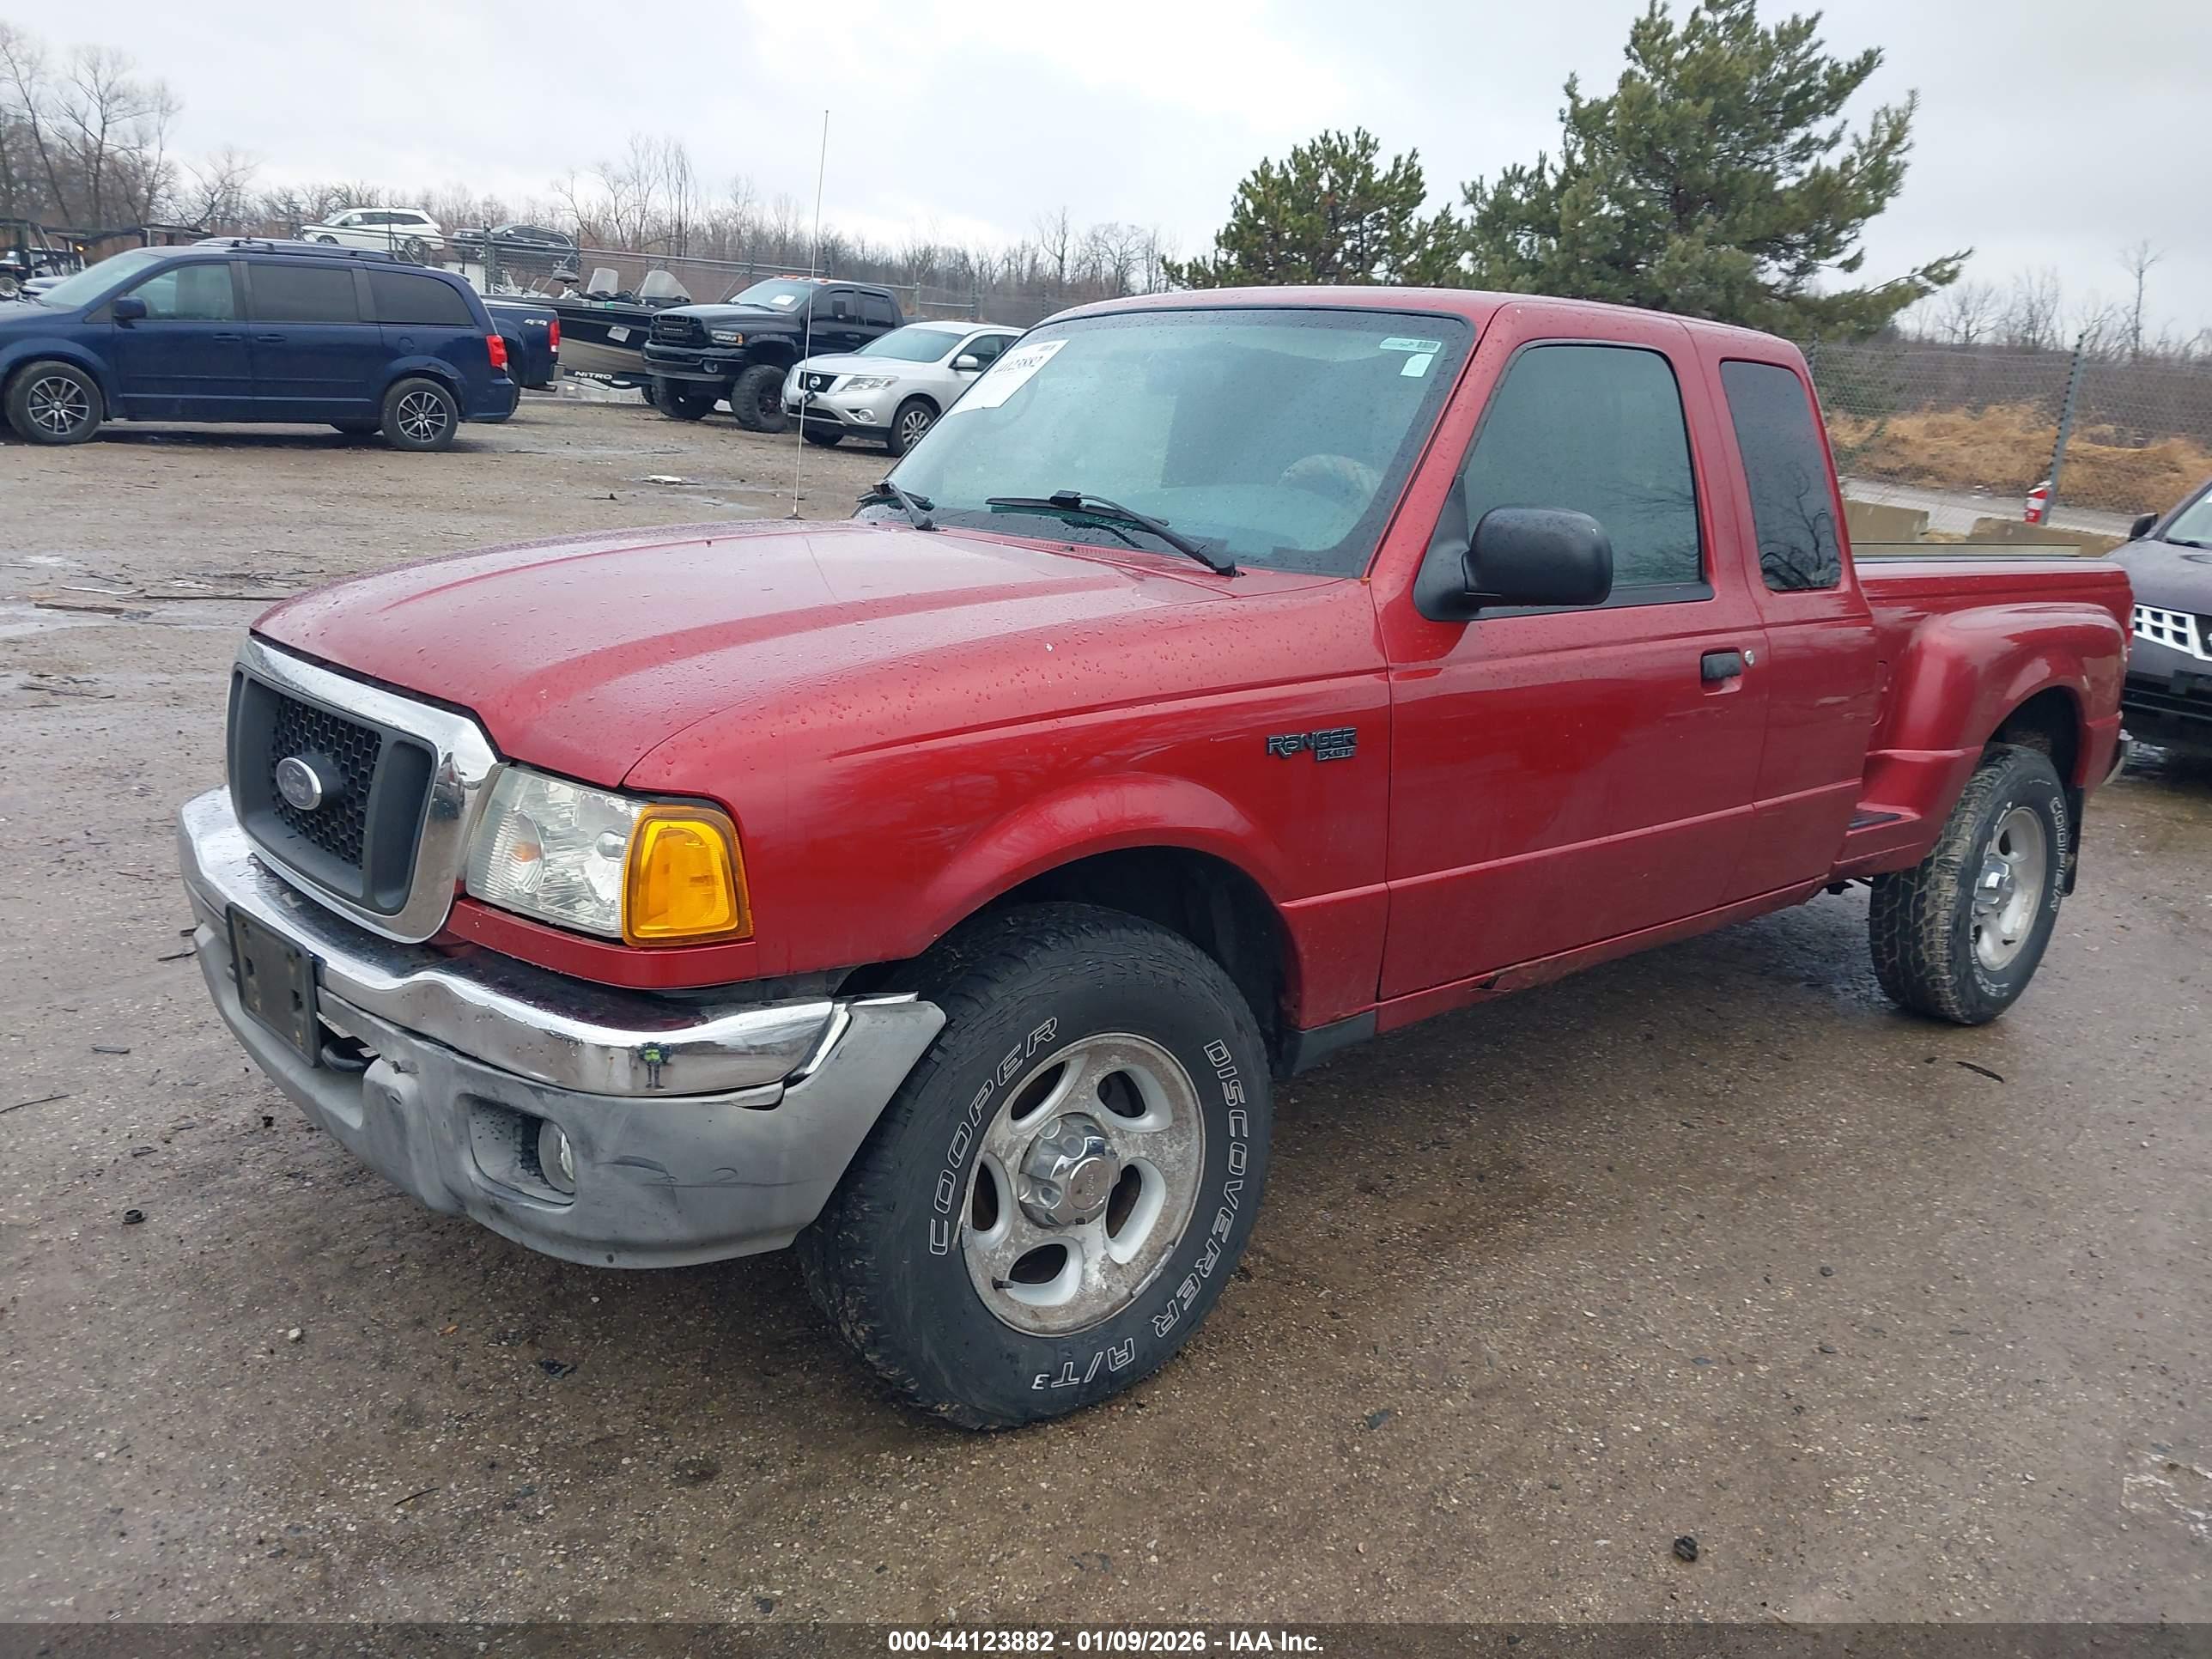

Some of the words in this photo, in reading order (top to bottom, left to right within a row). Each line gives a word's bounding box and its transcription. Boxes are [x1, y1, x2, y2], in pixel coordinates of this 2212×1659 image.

[1267, 727, 1357, 756] RANGER
[929, 1017, 1058, 1256] COOPER
[1151, 1039, 1249, 1339] DISCOVERER
